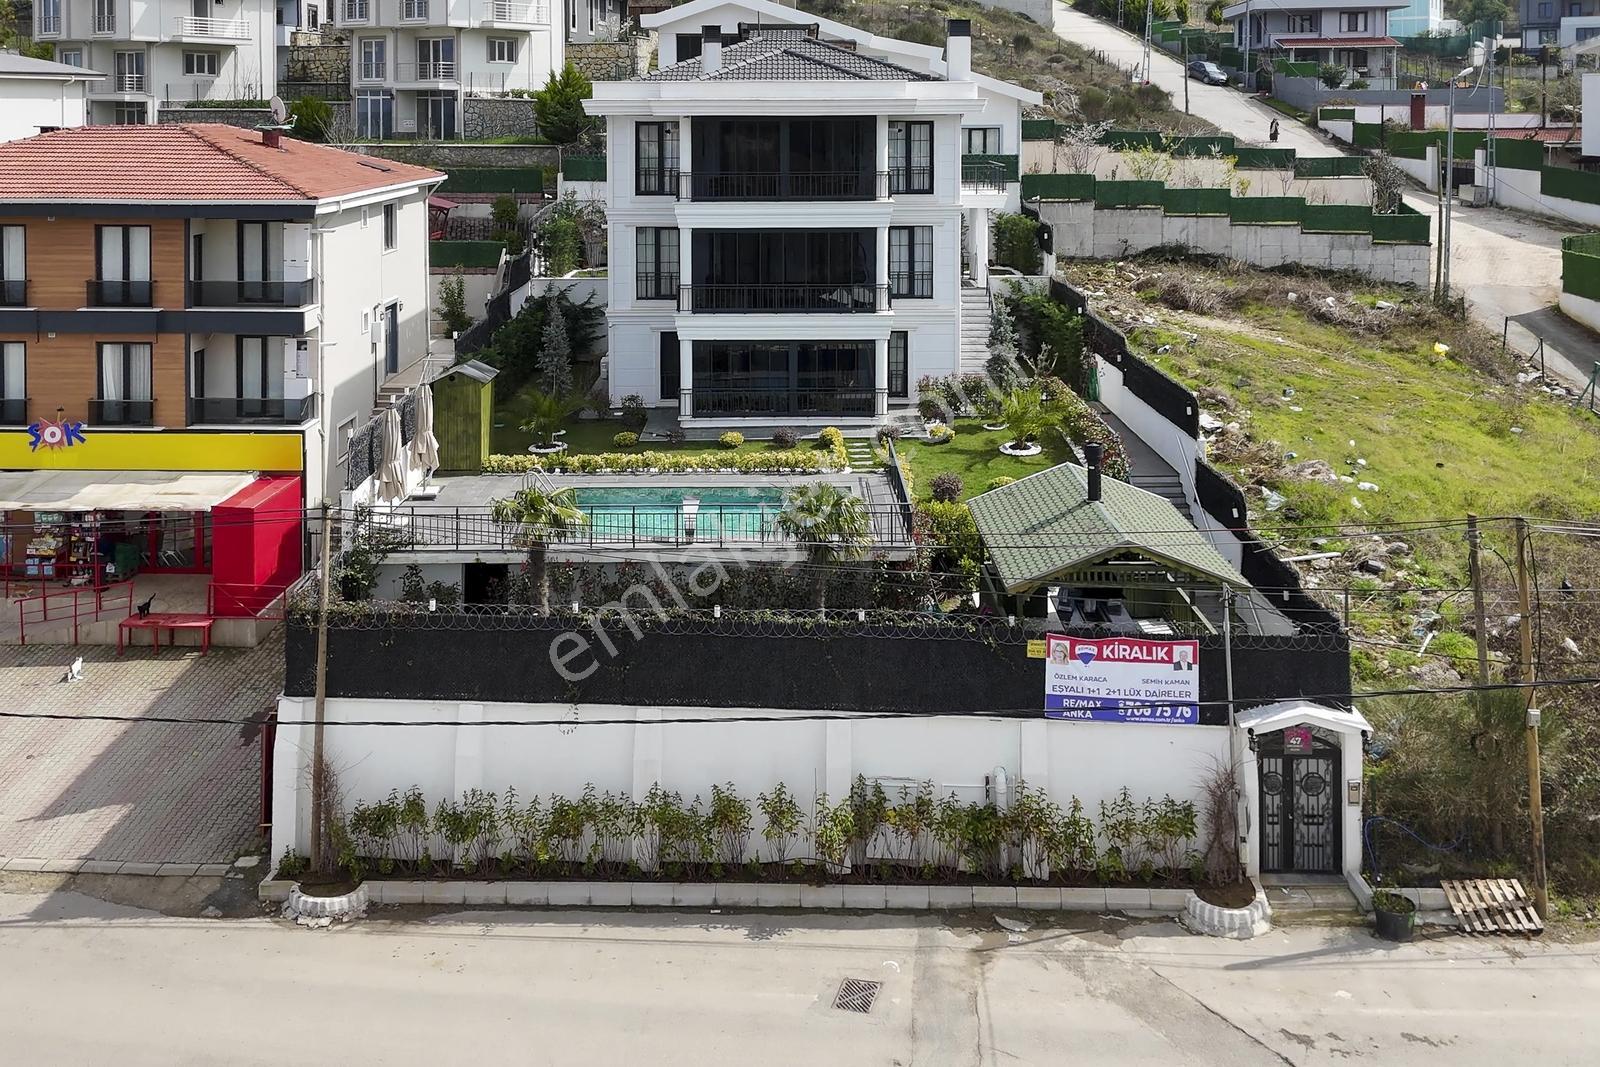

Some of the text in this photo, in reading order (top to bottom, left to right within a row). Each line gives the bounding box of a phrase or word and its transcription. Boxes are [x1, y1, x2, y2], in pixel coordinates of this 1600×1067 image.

[27, 422, 87, 452] ŞOK
[1103, 641, 1169, 661] KİRALIK
[1054, 673, 1108, 683] ÖZLEM KARACA
[1052, 684, 1192, 698] EŞYALI 1+1 2+1 LÜX DAİRELER
[1063, 698, 1102, 708] RE/MAX
[1063, 709, 1093, 719] ANKA
[1290, 736, 1302, 745] 47
